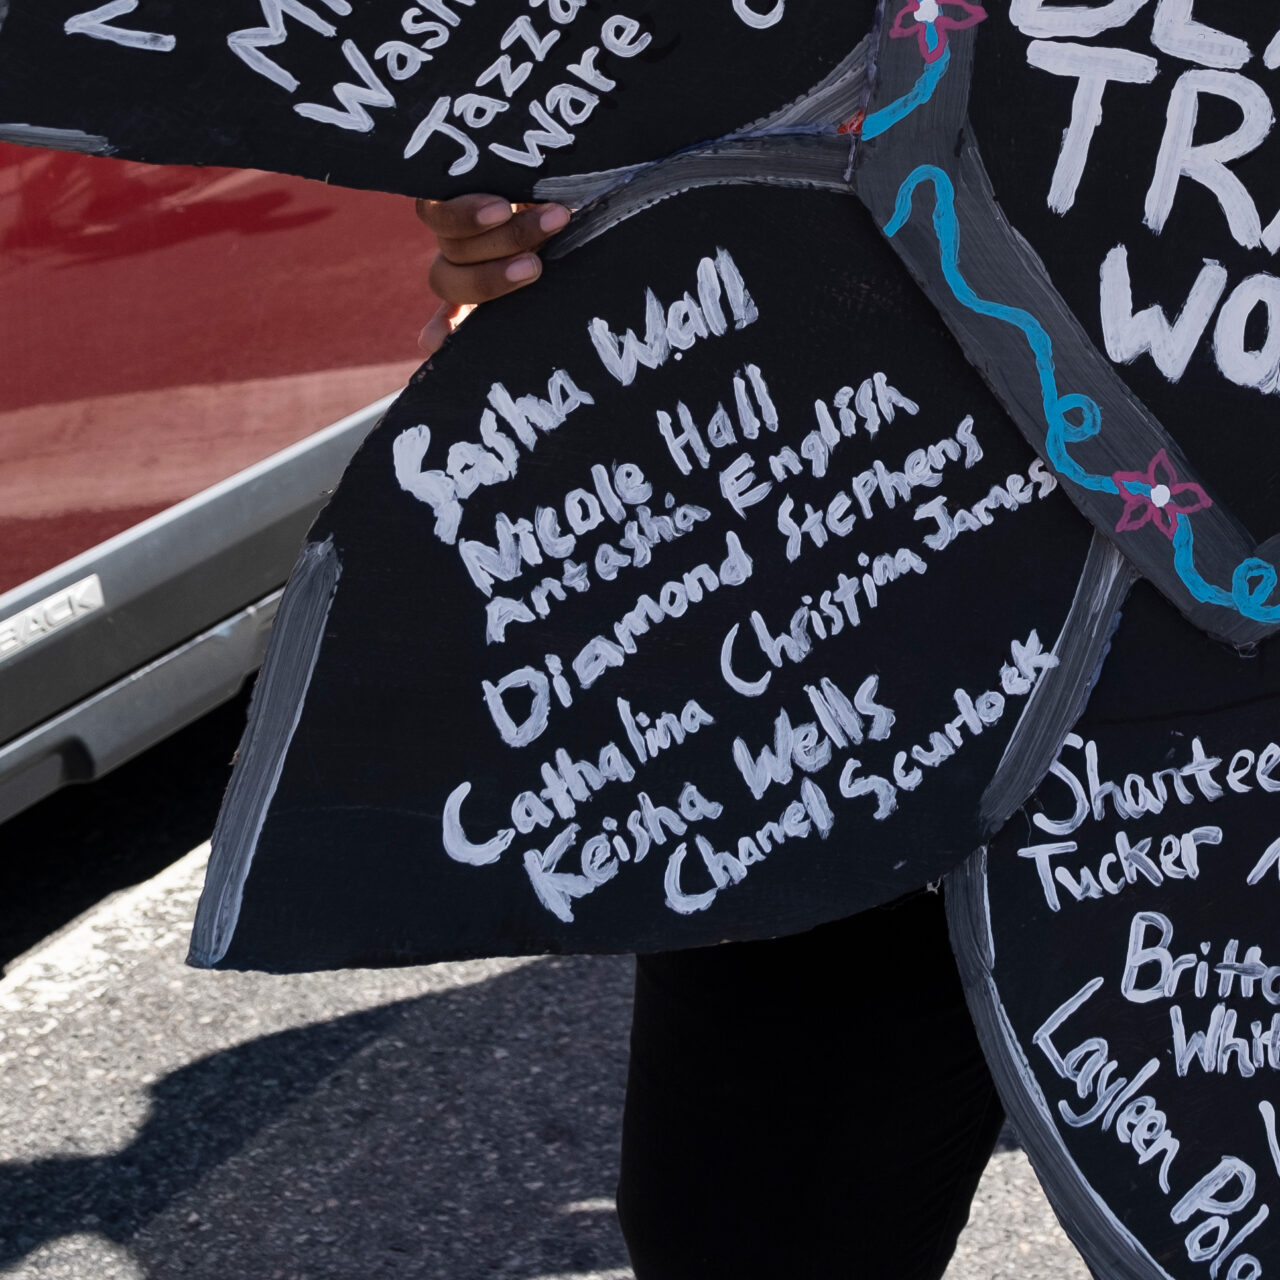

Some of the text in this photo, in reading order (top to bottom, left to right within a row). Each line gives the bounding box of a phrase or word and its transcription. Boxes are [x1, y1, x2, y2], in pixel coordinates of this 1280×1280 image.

[490, 12, 652, 168] Ware
[392, 245, 759, 546] Sasha Wall
[457, 363, 779, 599] Nicole Hall
[718, 370, 921, 520] English
[481, 413, 985, 748] Diamond Stephens
[720, 456, 1058, 698] Christina James
[442, 696, 717, 867] Cathalina
[523, 673, 897, 923] Keisha Wells
[663, 628, 1061, 915] Chanel Scurlock
[1016, 825, 1223, 913] Tucker
[1032, 977, 1180, 1195] Layleen
